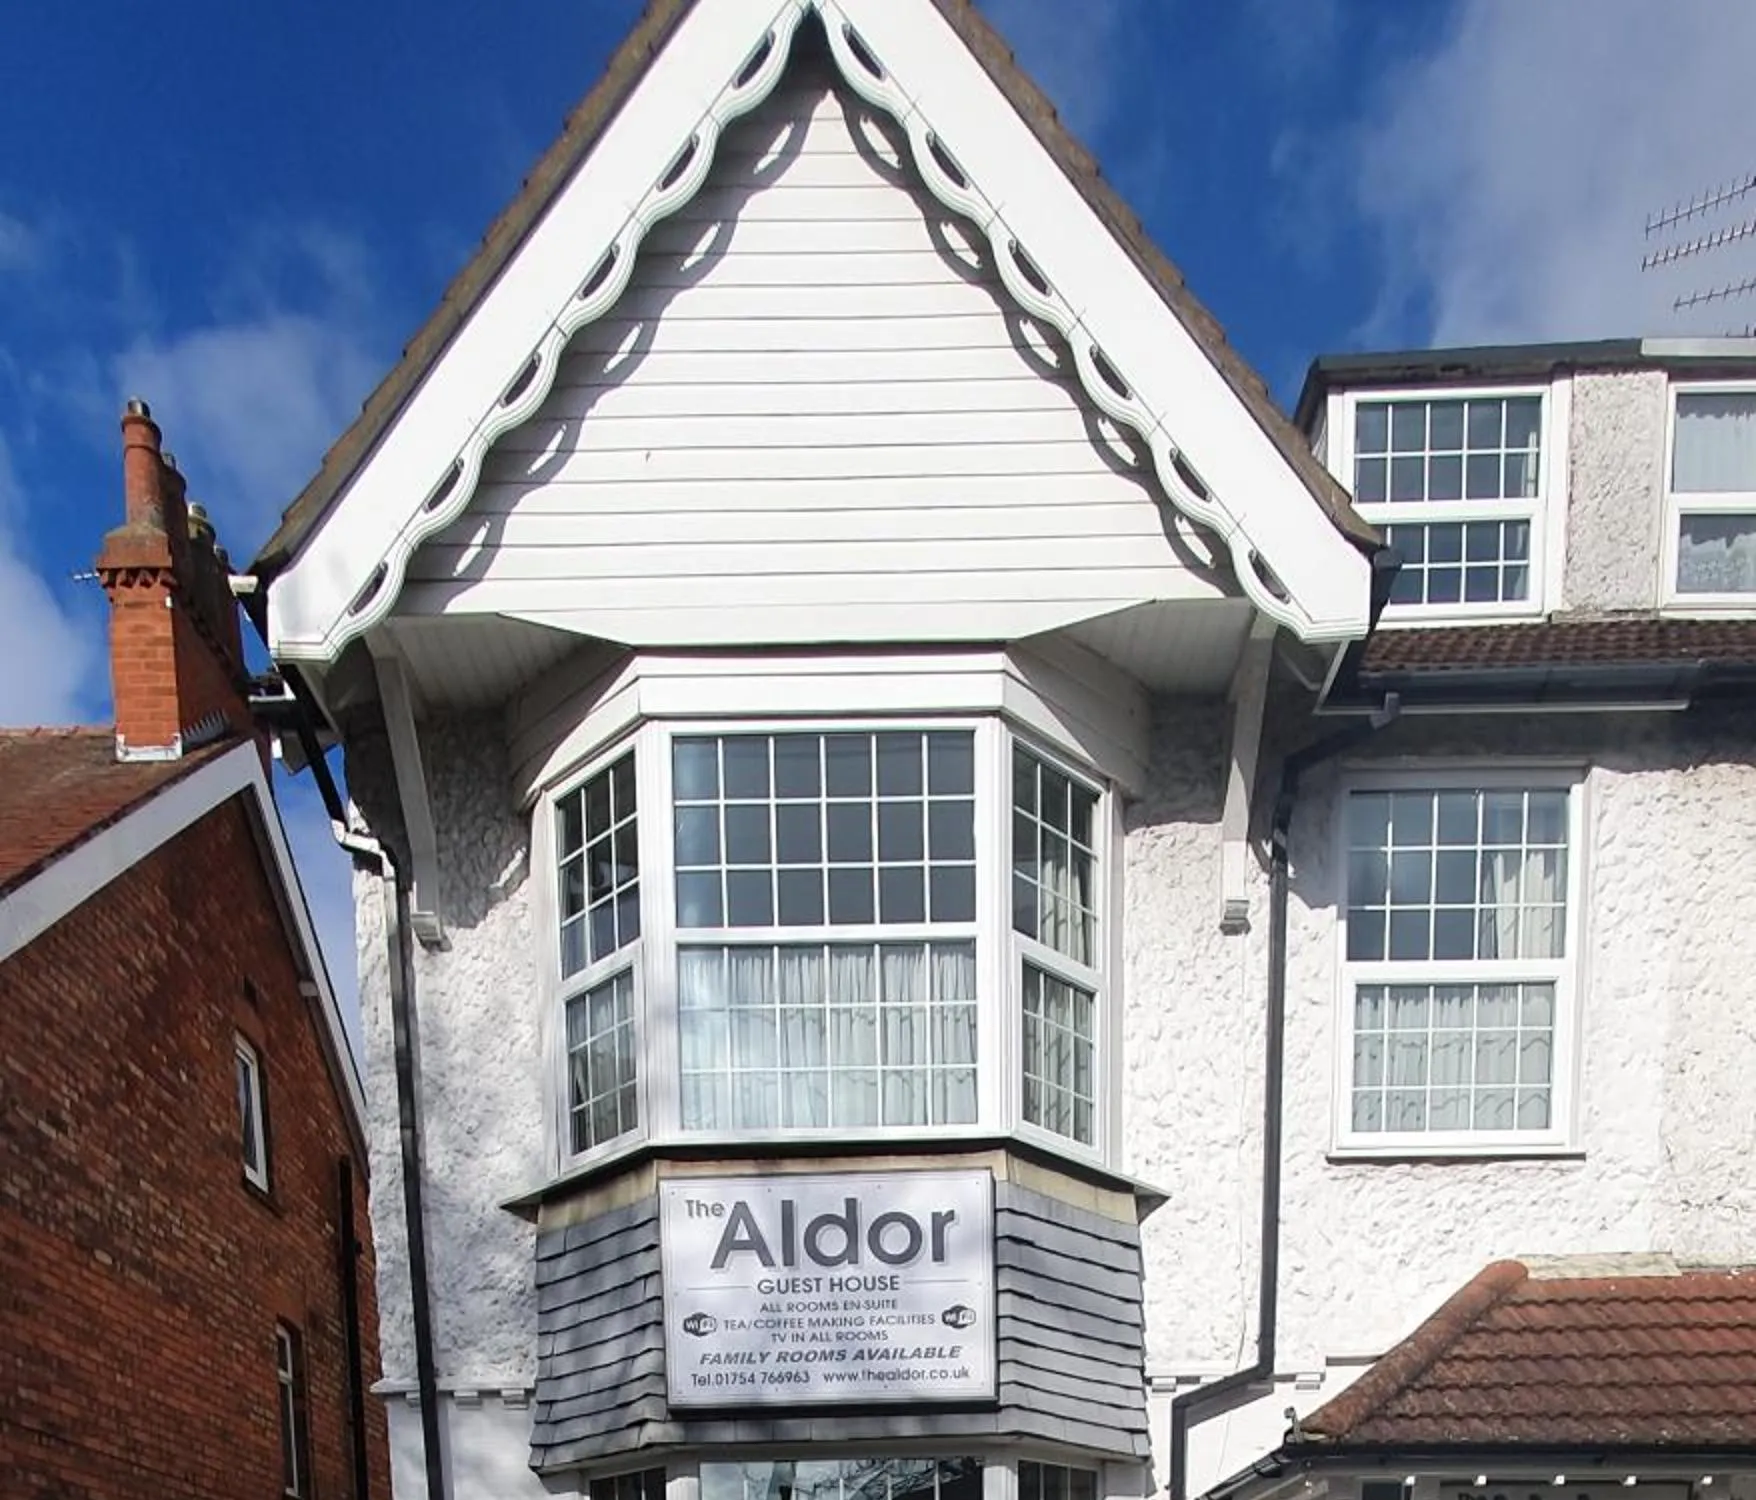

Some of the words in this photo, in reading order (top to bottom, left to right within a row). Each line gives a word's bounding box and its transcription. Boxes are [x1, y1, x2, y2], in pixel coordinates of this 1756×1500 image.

[686, 1199, 725, 1218] The
[710, 1198, 955, 1269] Aldor
[757, 1278, 823, 1294] GUEST
[829, 1275, 901, 1292] HOUSE
[760, 1302, 782, 1312] ALL
[786, 1300, 839, 1312] ROOMS
[808, 1316, 865, 1327] MAKING
[869, 1313, 936, 1325] FACILITIES
[771, 1333, 787, 1343] TV
[791, 1332, 805, 1342] IN
[809, 1331, 830, 1343] ALL
[835, 1330, 888, 1341] ROOMS
[700, 1351, 771, 1365] FAMILY
[775, 1349, 847, 1363] ROOMS
[852, 1345, 962, 1361] AVAILABLE
[761, 1370, 810, 1385] 766963
[823, 1365, 969, 1382] www.thealdor.co.uk
